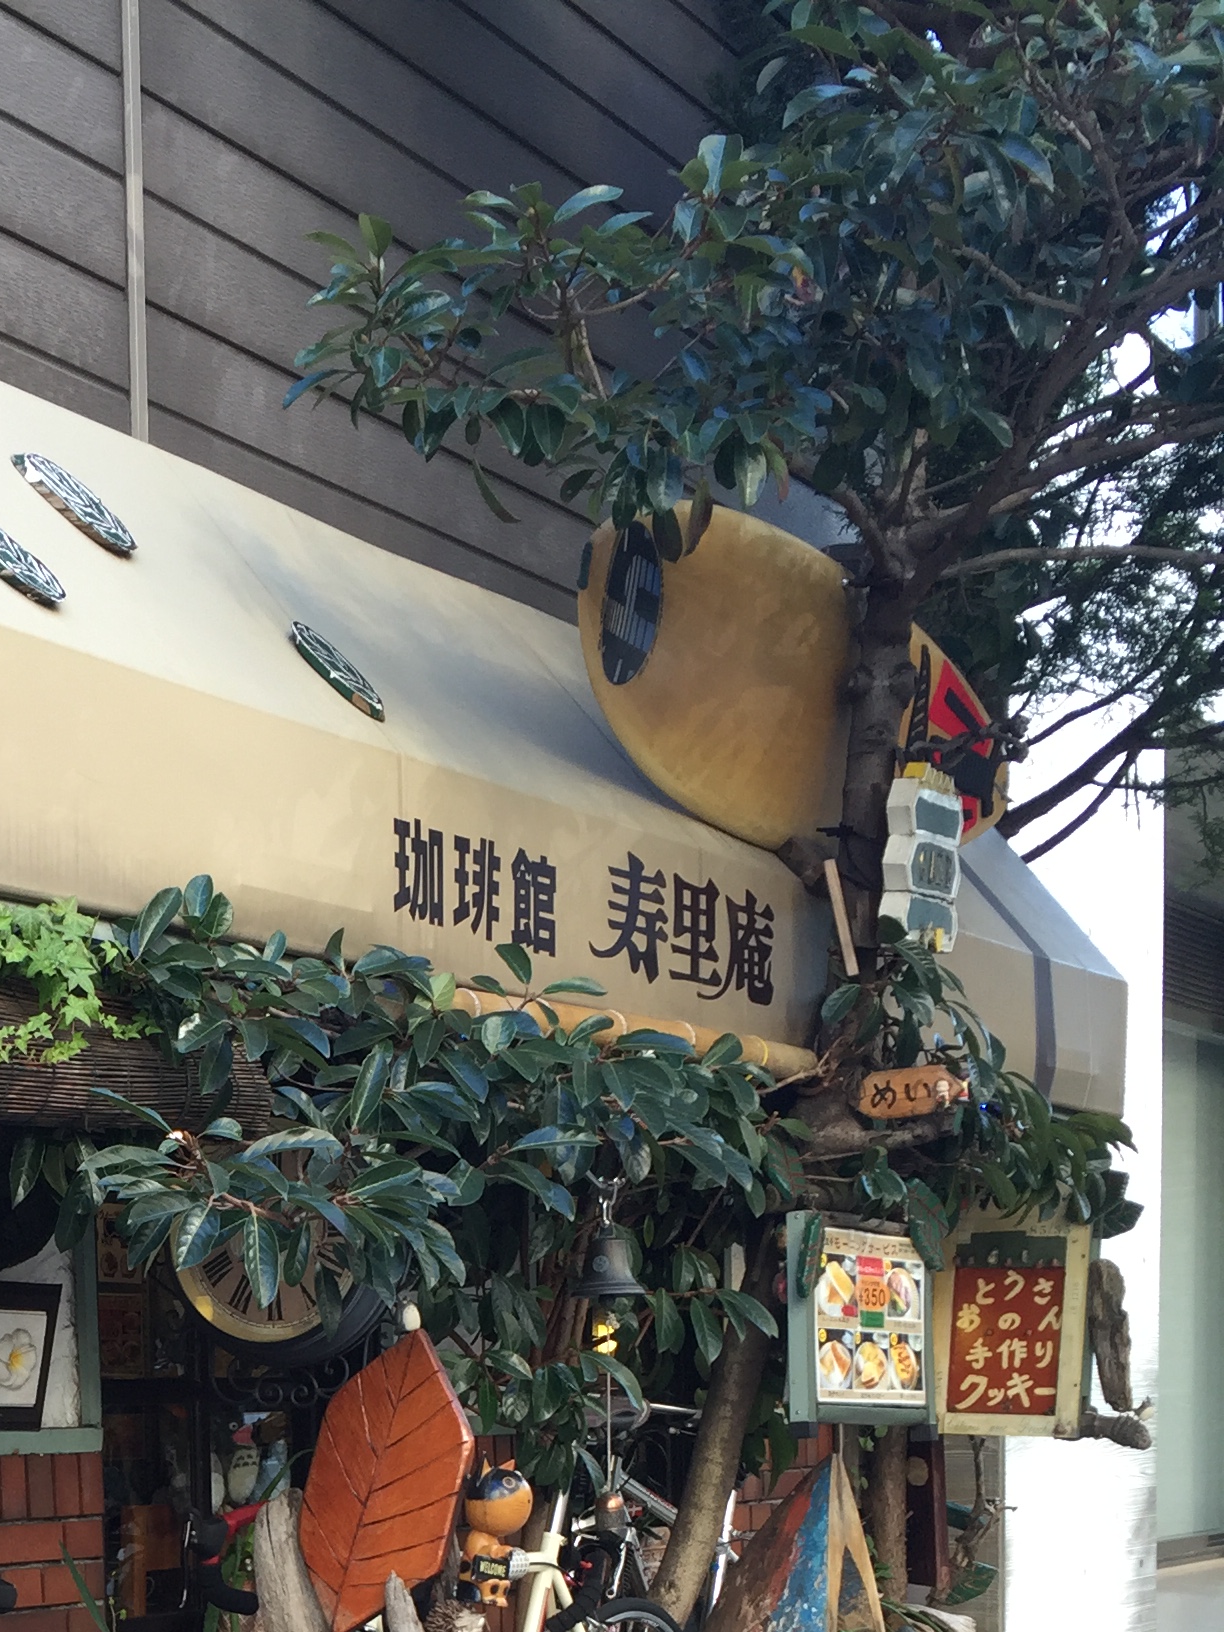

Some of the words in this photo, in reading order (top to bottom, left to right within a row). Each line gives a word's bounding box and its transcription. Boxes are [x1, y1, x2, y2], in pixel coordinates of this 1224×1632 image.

[393, 817, 557, 958] 珈琲館
[588, 850, 776, 1007] 寿里庵
[871, 1080, 931, 1109] めい
[965, 1337, 1054, 1370] 手作り
[955, 1371, 1057, 1410] クッキー
[479, 1560, 507, 1578] WELCOME
